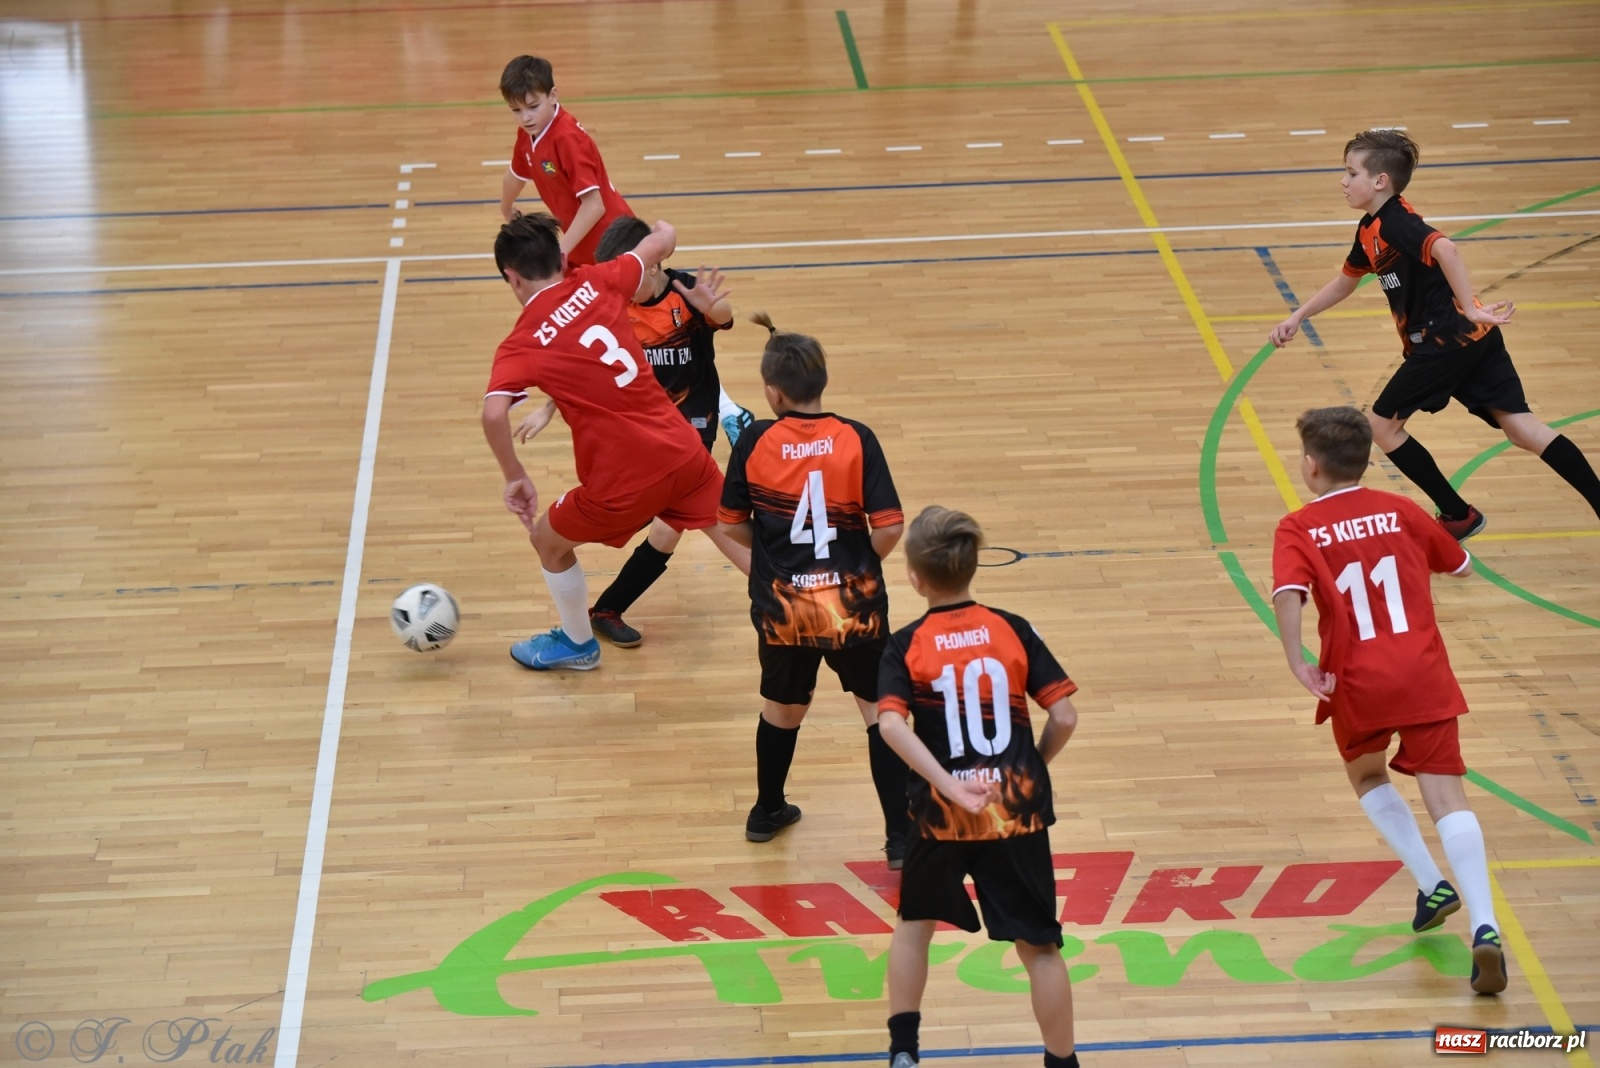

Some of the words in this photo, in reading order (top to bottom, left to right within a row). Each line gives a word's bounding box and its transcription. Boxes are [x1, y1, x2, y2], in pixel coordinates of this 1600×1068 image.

[533, 321, 558, 347] ZS
[549, 281, 600, 328] KIETRZ
[578, 324, 639, 389] 3
[781, 435, 834, 460] PŁOMIEŃ
[789, 469, 837, 560] 4
[1331, 511, 1402, 543] KIETRZ
[1334, 555, 1409, 642] 11
[934, 624, 991, 651] PŁOMIEŃ
[930, 656, 1012, 760] 10
